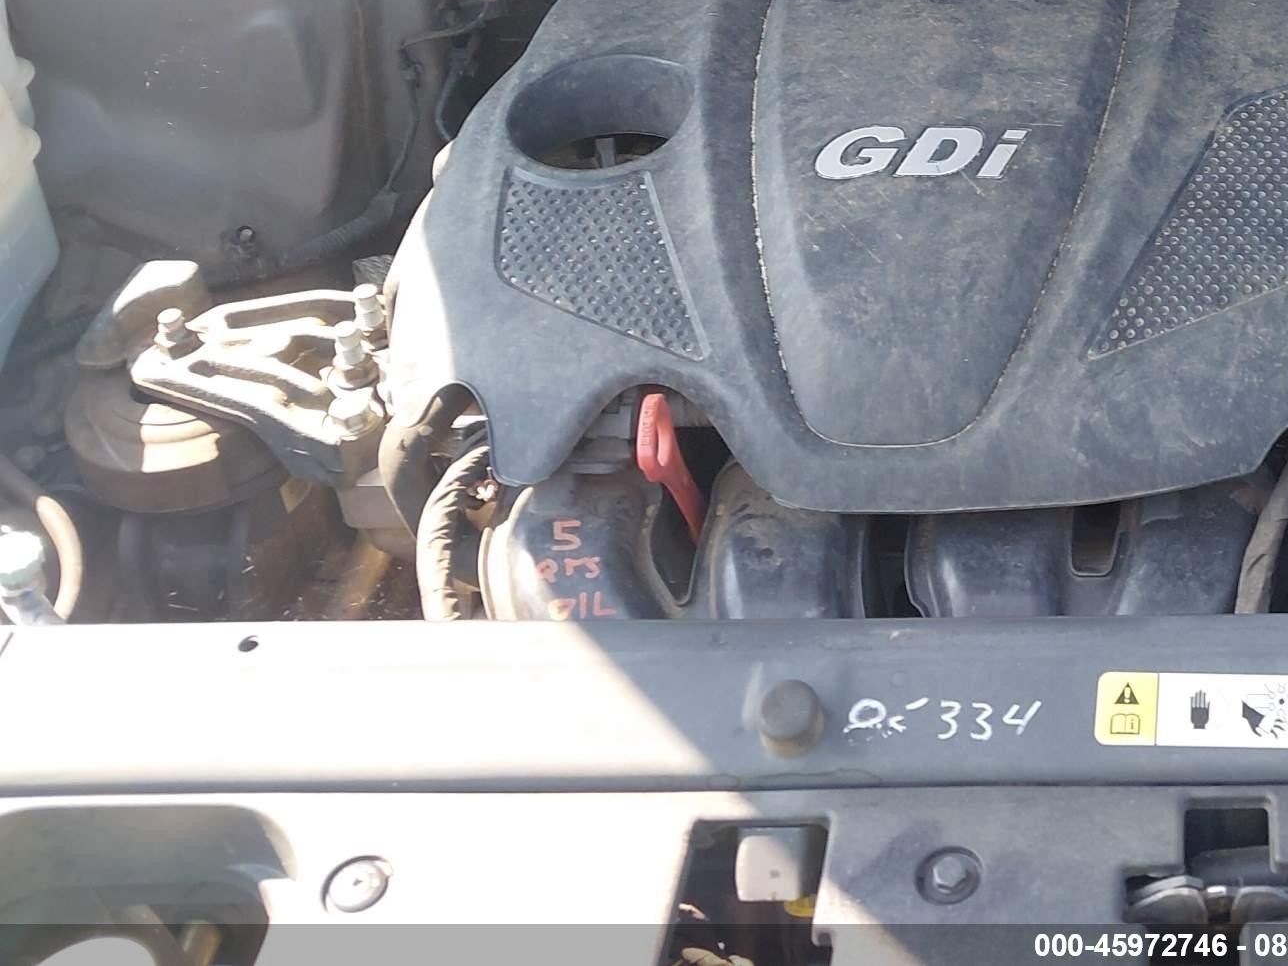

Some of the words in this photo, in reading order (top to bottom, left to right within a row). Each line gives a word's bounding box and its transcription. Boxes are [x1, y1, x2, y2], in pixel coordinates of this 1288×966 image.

[815, 125, 1032, 179] GDi
[551, 519, 582, 551] 5
[547, 591, 617, 621] OIL
